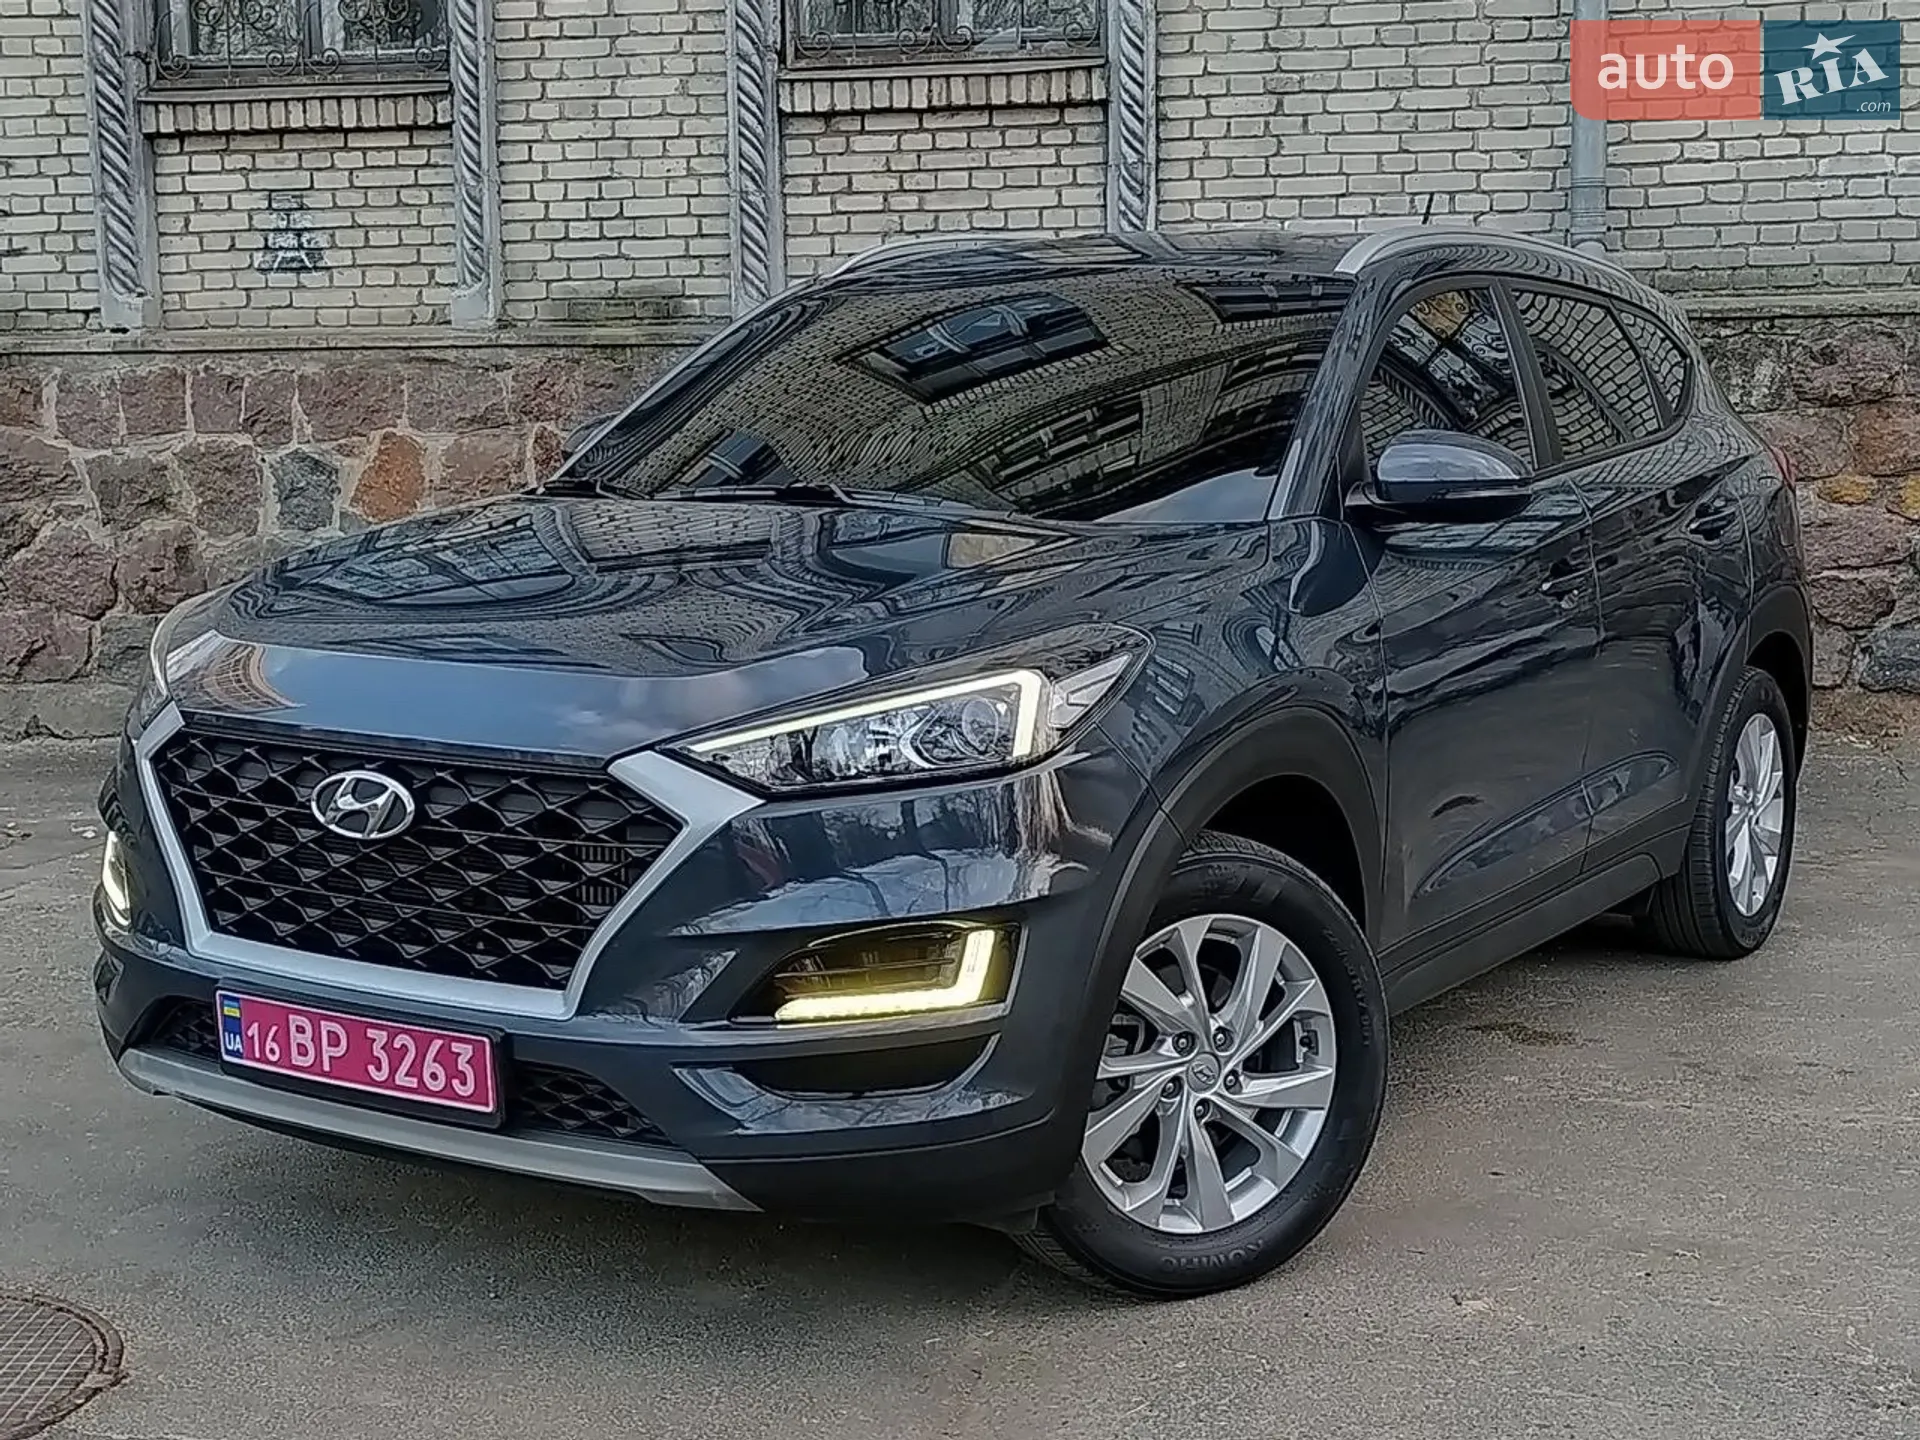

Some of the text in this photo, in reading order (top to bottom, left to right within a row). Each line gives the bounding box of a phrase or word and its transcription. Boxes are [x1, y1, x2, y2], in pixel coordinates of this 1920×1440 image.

[224, 1031, 243, 1053] UA
[246, 1014, 476, 1097] 16 BP 3263
